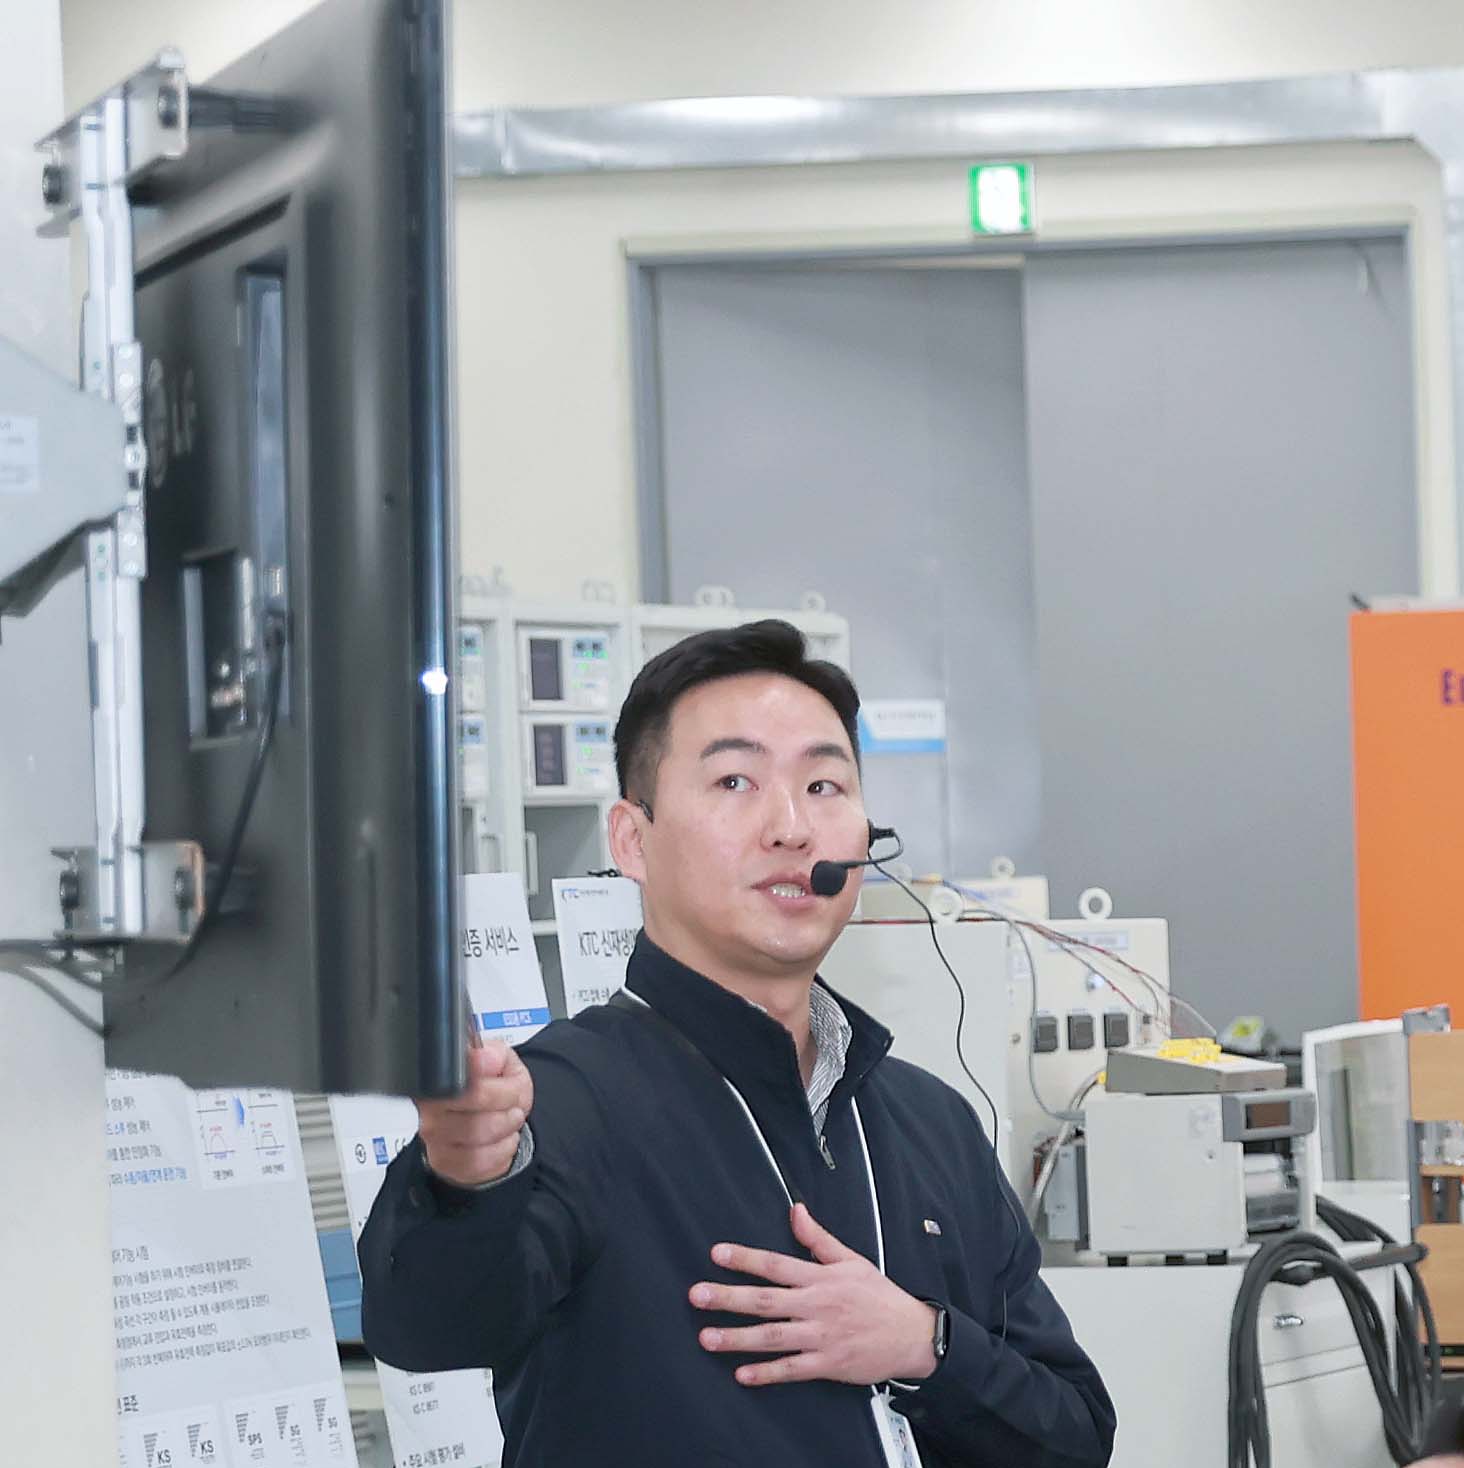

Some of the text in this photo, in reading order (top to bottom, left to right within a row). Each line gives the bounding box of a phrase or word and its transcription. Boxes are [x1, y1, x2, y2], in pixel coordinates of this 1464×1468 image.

[485, 925, 519, 956] 서비스
[578, 930, 599, 956] KTC
[247, 1432, 263, 1446] SPS
[200, 1440, 214, 1454] KS
[157, 1449, 172, 1464] KS
